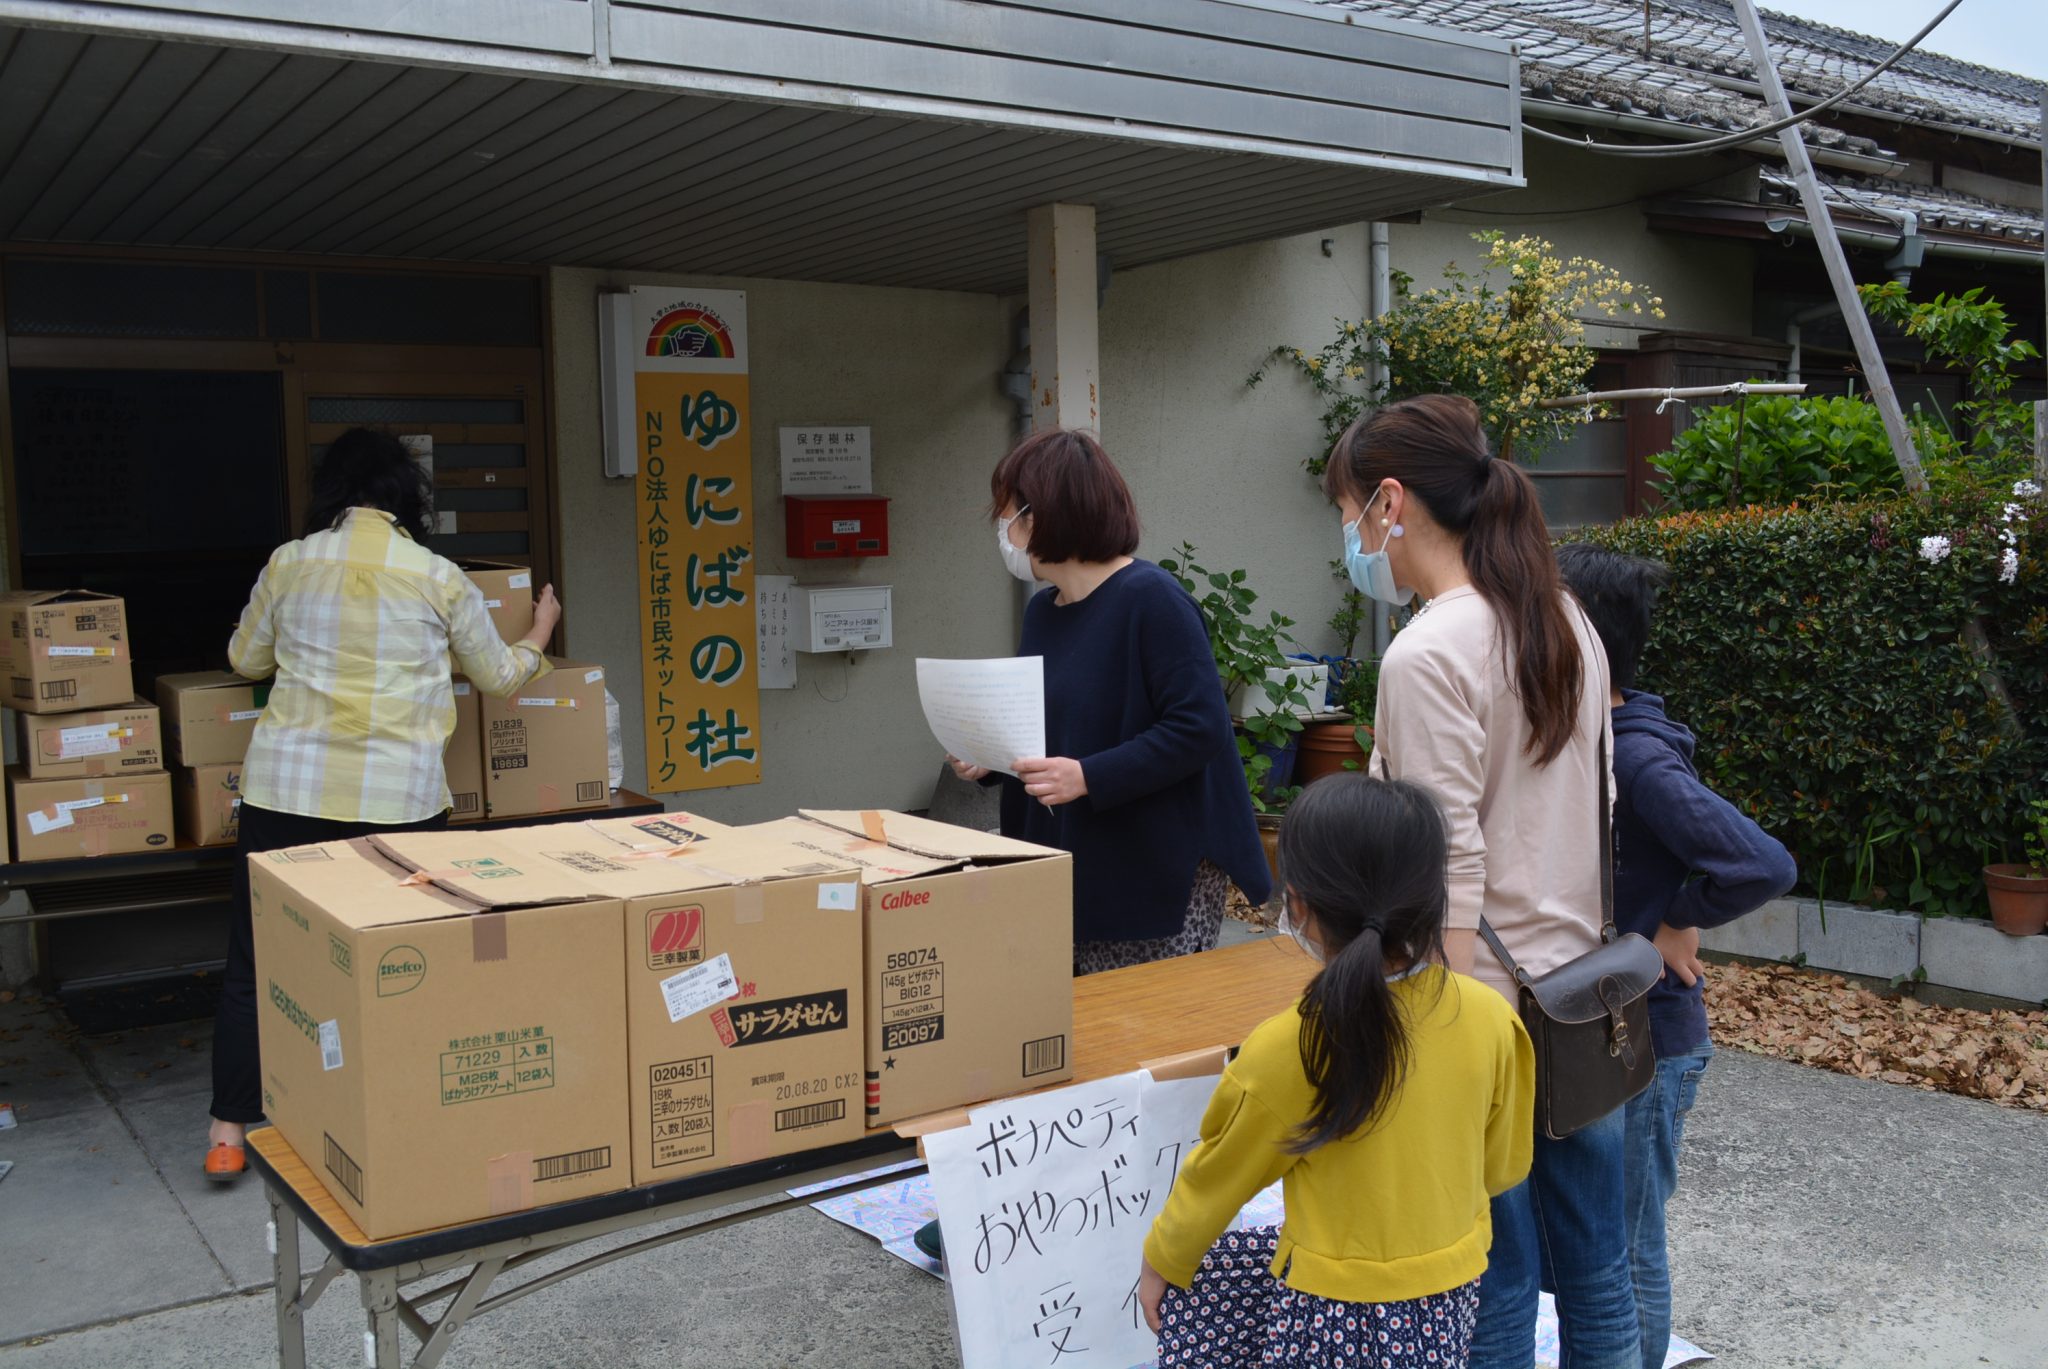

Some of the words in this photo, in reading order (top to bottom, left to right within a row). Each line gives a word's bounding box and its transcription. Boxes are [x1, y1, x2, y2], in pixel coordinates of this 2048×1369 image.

[797, 432, 855, 445] 保存樹林
[681, 390, 756, 771] ゆにばの杜
[646, 411, 677, 783] NPO法人ゆにば市民ネットワーク
[492, 718, 523, 729] 51239
[494, 758, 525, 769] 19693
[880, 891, 931, 911] Calbee
[651, 949, 701, 966] 三幸製菓
[887, 947, 938, 970] 58074
[387, 961, 422, 975] Befco
[885, 975, 906, 988] 145g
[900, 984, 931, 1000] BIG12
[735, 1001, 843, 1041] サラダせん
[888, 1022, 939, 1048] 20097
[519, 1042, 548, 1059] 入数
[455, 1050, 501, 1069] 71229
[459, 1069, 499, 1086] M26枚
[516, 1067, 552, 1083] 12袋入
[654, 1063, 694, 1082] 02045
[700, 1061, 707, 1074] 1
[751, 1072, 785, 1087] 賞味期限
[444, 1080, 514, 1101] ばかうけアソート
[653, 1087, 673, 1101] 18枚
[776, 1078, 828, 1101] 20.08.20
[834, 1072, 859, 1090] CX2
[653, 1096, 711, 1118] 三幸のサラダせん
[655, 1123, 680, 1138] 入数
[684, 1118, 711, 1133] 20袋入
[976, 1098, 1140, 1178] ボナペティ
[660, 1145, 706, 1160] 三幸製菓株式会社
[974, 1138, 1202, 1275] おやつボック
